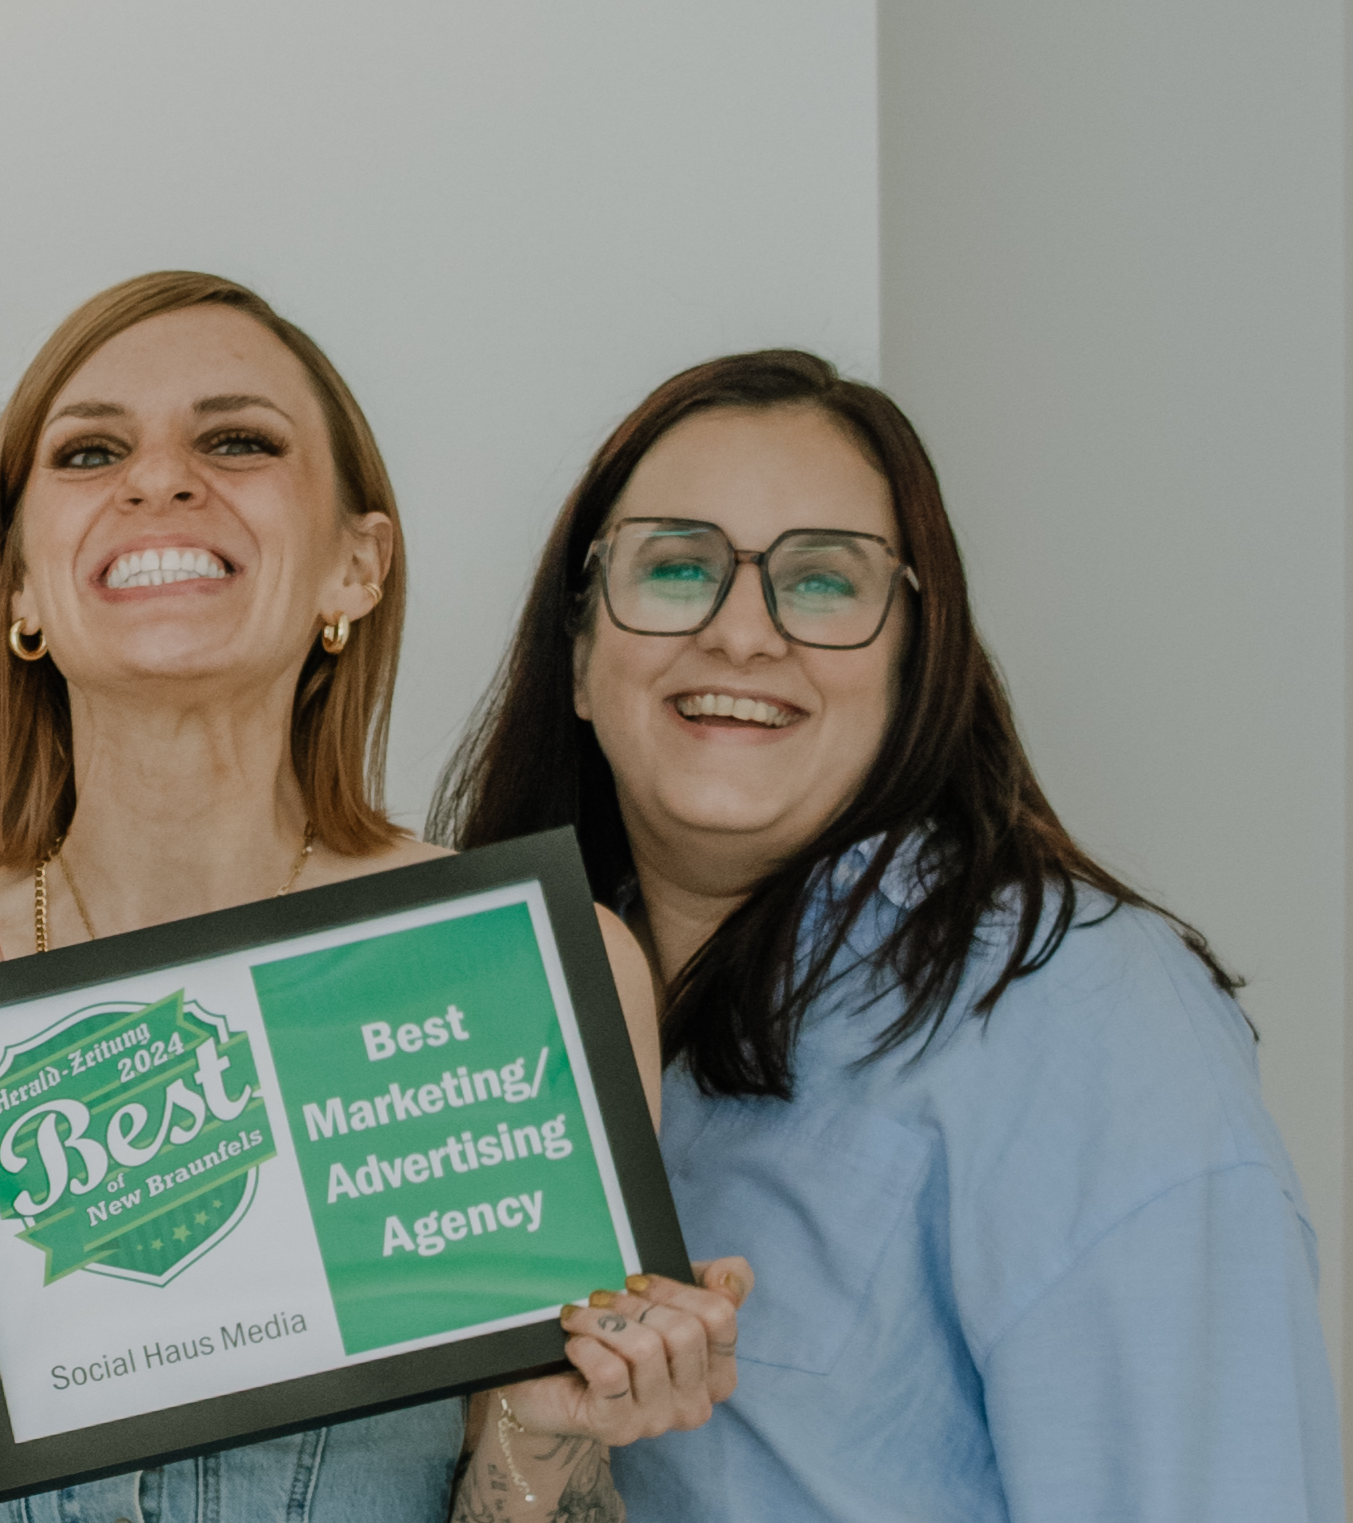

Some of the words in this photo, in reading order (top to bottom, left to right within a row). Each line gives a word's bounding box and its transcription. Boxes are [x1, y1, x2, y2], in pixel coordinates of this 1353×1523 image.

[117, 1031, 185, 1084] 2024
[360, 1003, 470, 1062] Best
[0, 1036, 252, 1217] Best
[301, 1045, 550, 1142] Marketing/
[86, 1187, 142, 1228] New
[145, 1128, 264, 1198] Braunfels
[106, 1171, 126, 1193] of
[326, 1113, 573, 1205] Advertising
[382, 1189, 543, 1258] Agency
[50, 1348, 137, 1391] Social
[142, 1335, 216, 1370] Haus
[219, 1311, 308, 1351] Media
